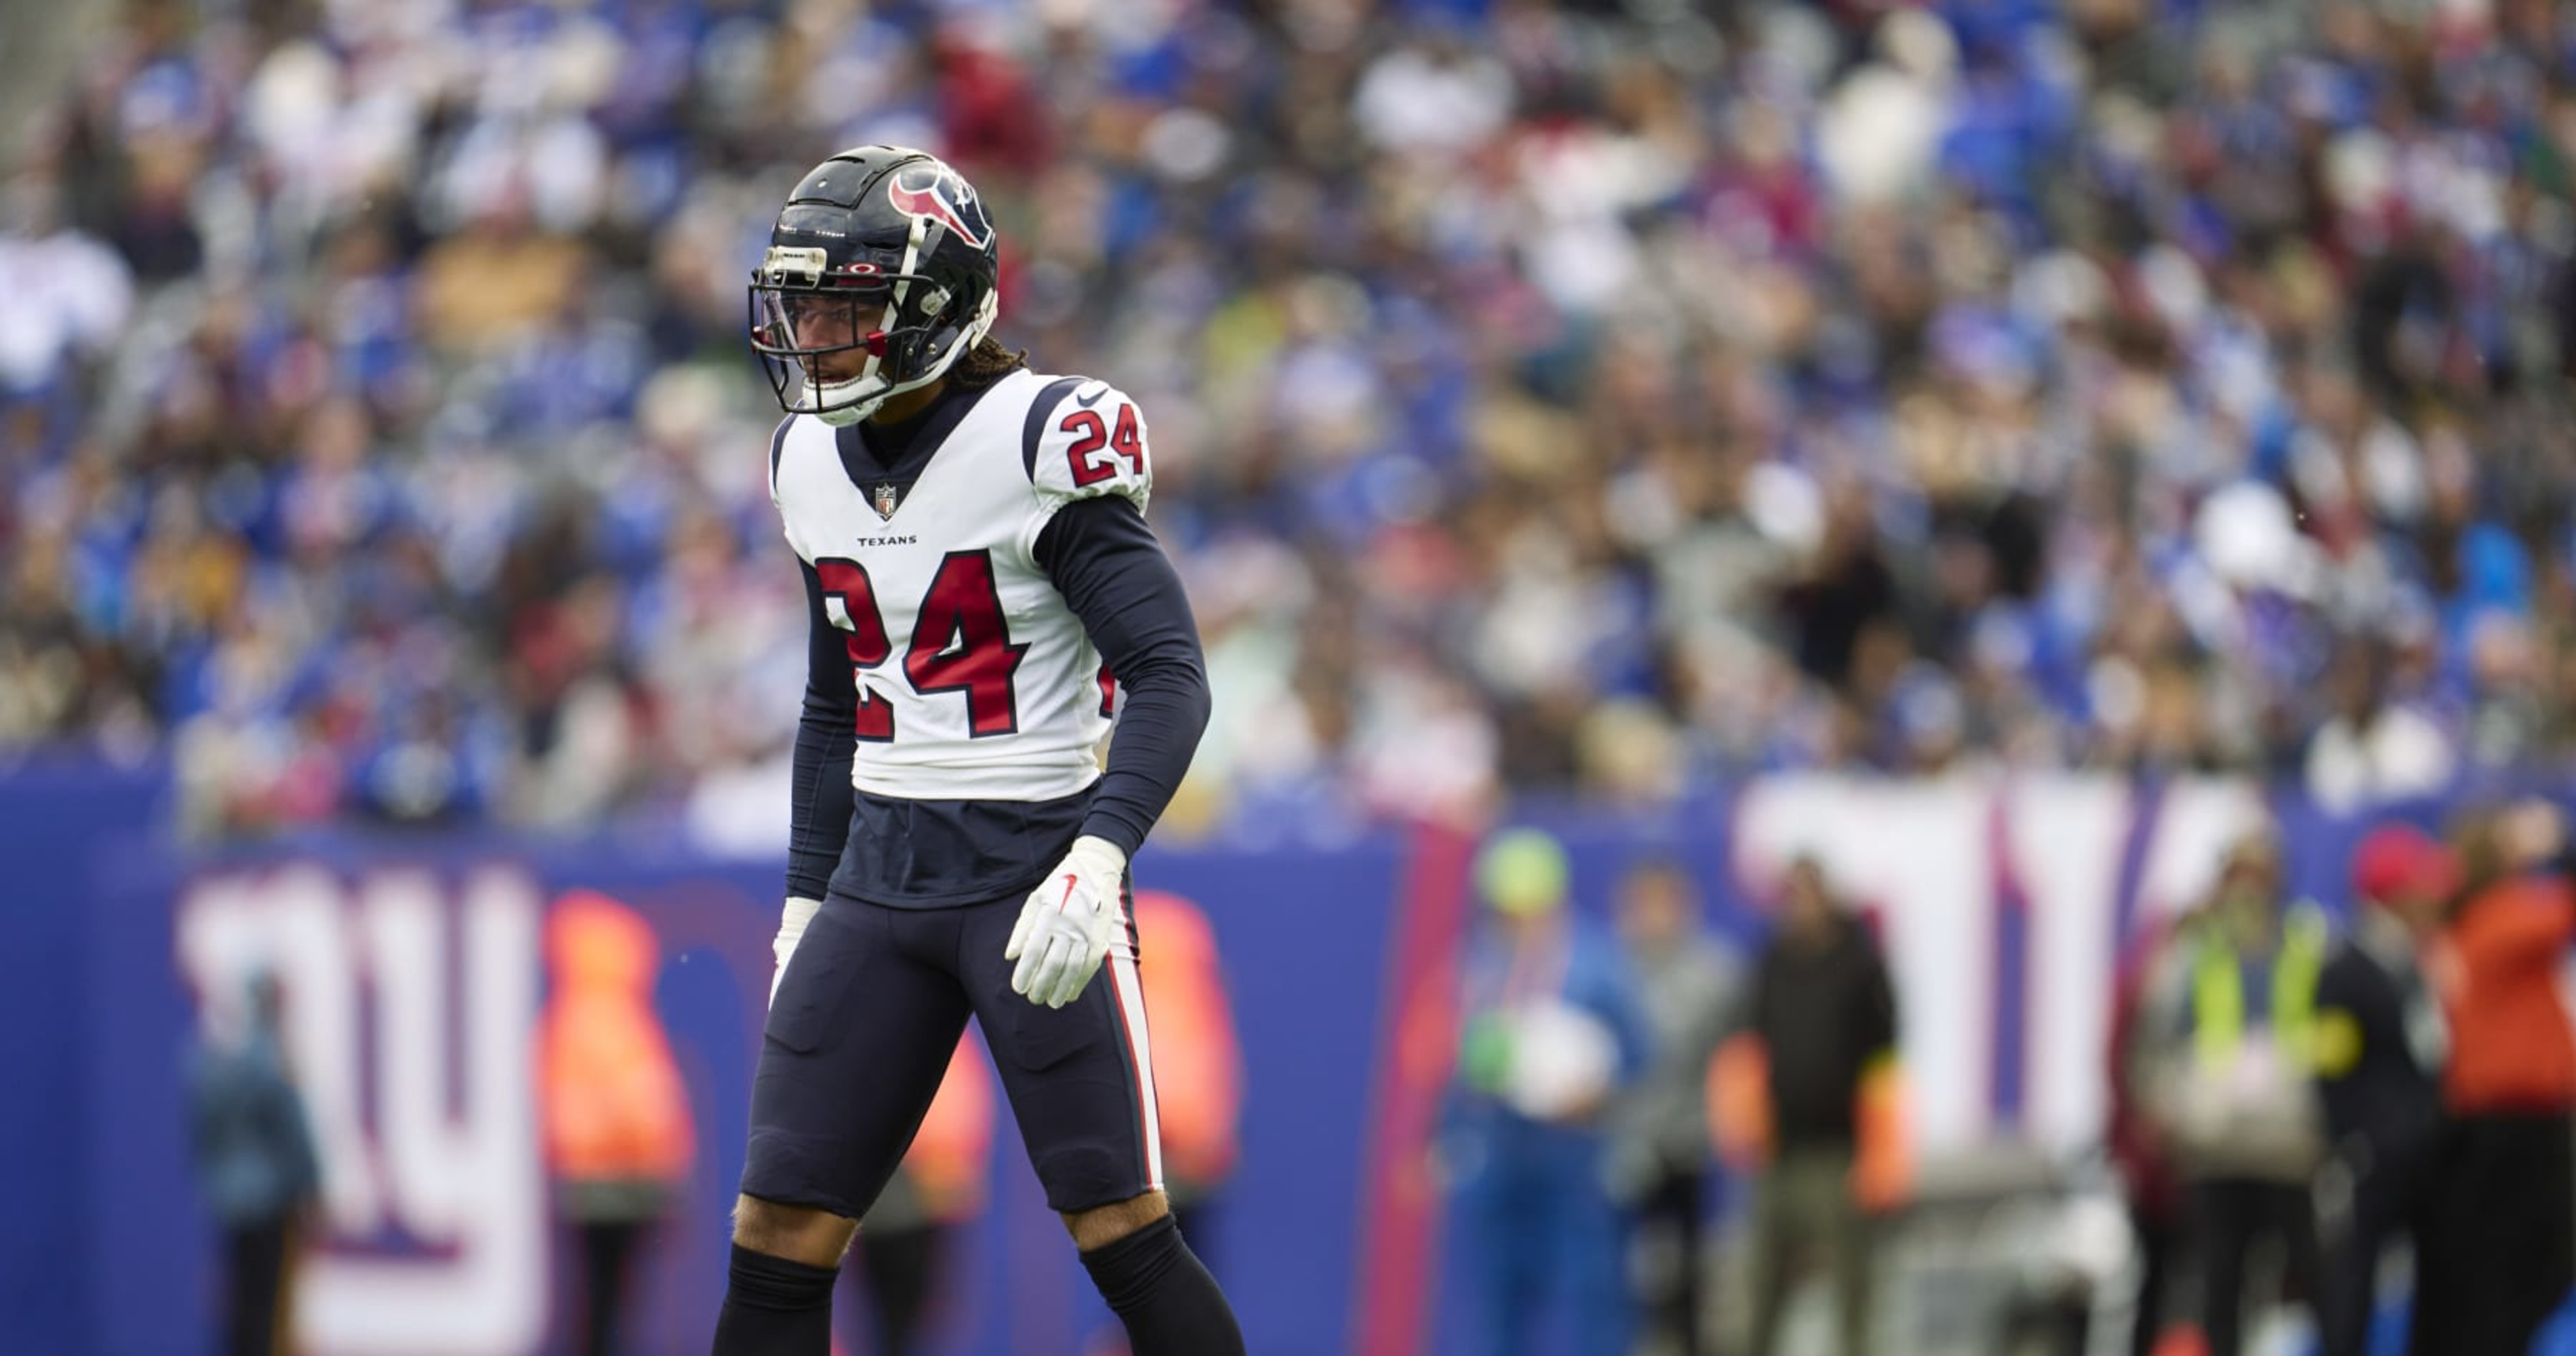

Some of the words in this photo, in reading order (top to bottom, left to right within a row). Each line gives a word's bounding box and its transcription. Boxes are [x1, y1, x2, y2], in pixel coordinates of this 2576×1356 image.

[1060, 403, 1143, 487] 24
[857, 535, 917, 546] TEXANS
[815, 549, 1031, 743] 24
